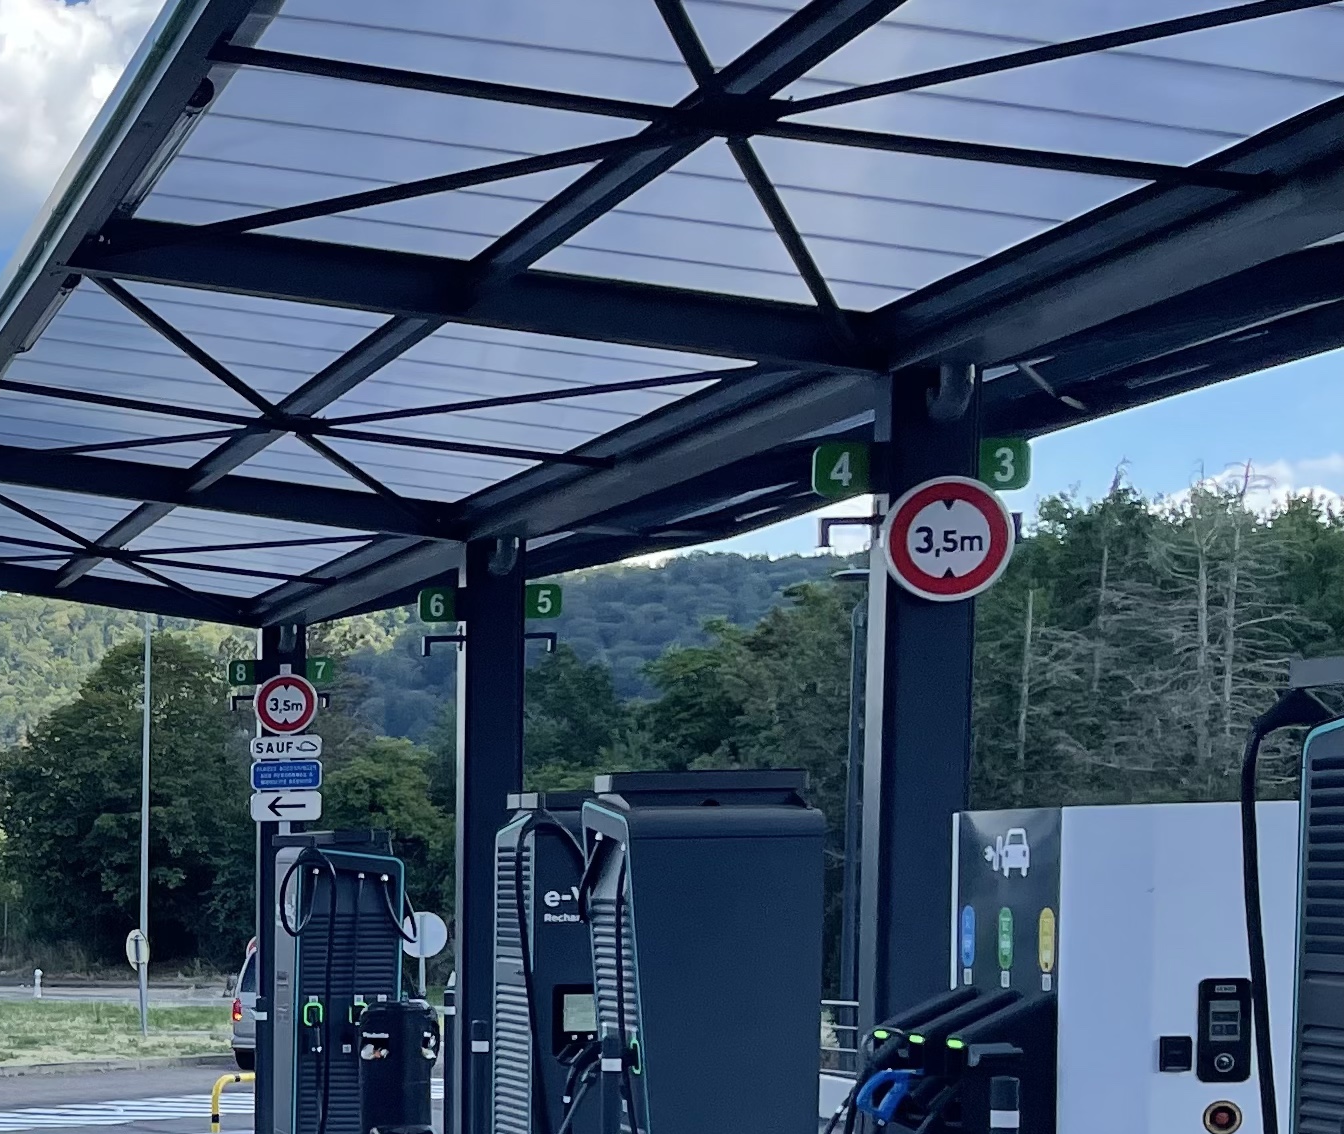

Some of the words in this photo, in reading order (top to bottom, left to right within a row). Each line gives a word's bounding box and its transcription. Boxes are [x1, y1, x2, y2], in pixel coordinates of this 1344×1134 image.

[829, 451, 853, 487] 4
[993, 447, 1014, 482] 3
[914, 526, 984, 558] 3,5m
[430, 593, 445, 617] 6
[537, 590, 552, 613] 5
[236, 663, 246, 682] 8
[315, 661, 326, 679] 7
[269, 697, 303, 714] 3,5m
[255, 742, 294, 754] SAUF
